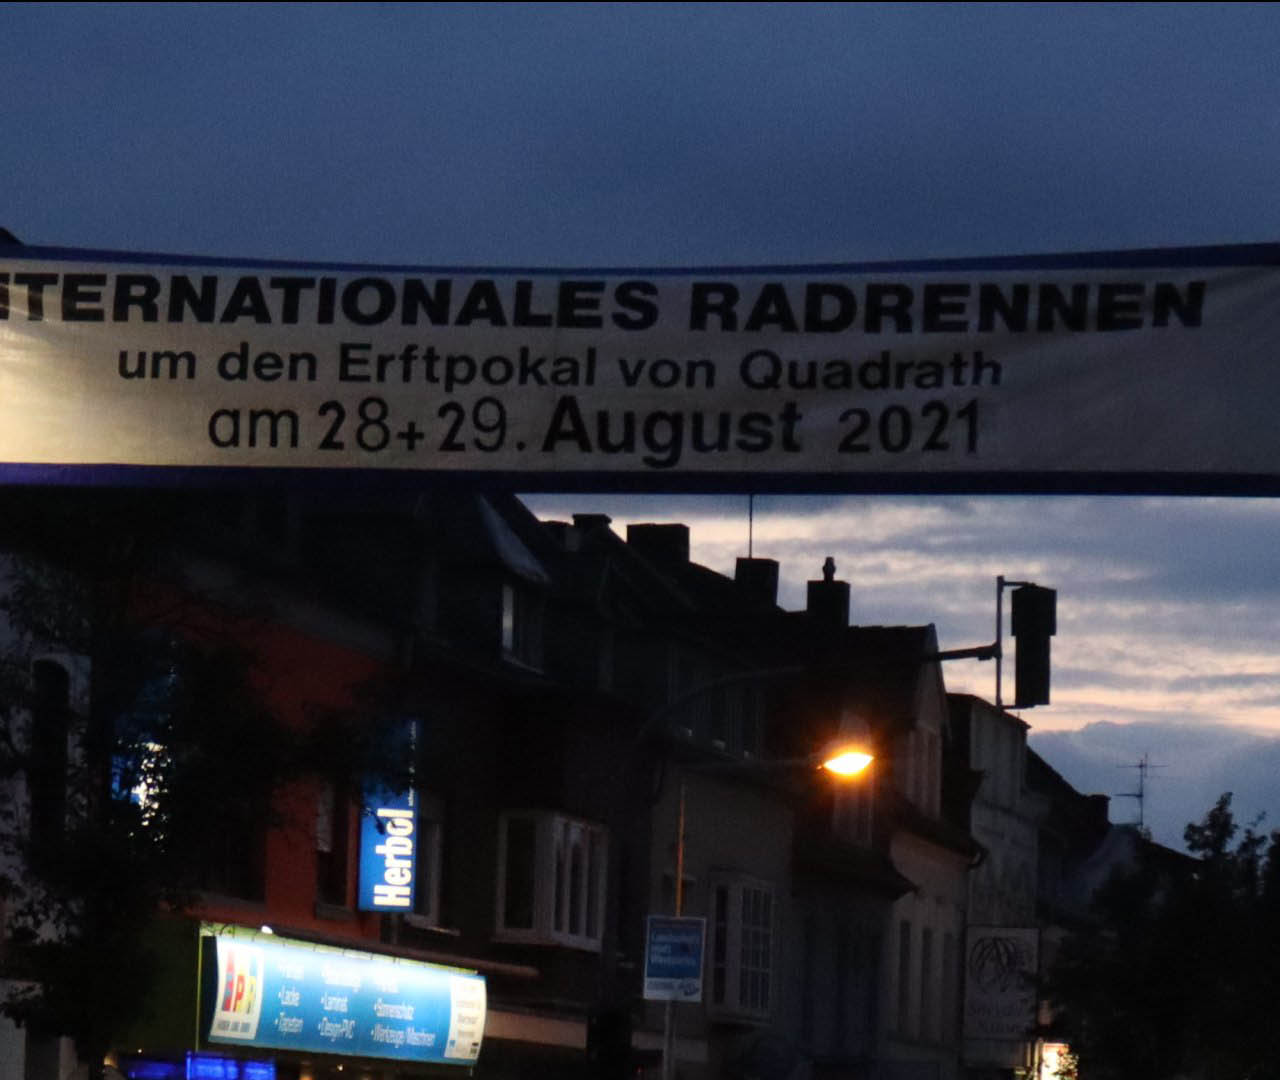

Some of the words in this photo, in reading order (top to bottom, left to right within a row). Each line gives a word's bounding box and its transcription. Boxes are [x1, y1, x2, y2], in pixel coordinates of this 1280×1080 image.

[688, 281, 1207, 334] RADRENNEN
[119, 351, 197, 380] um
[218, 342, 318, 382] den
[337, 343, 597, 393] Erftpokal
[619, 355, 716, 389] von
[738, 348, 1004, 391] Quadrath
[208, 408, 300, 449] am
[541, 397, 803, 468] August
[837, 400, 981, 454] 2021
[373, 808, 415, 907] Herbol
